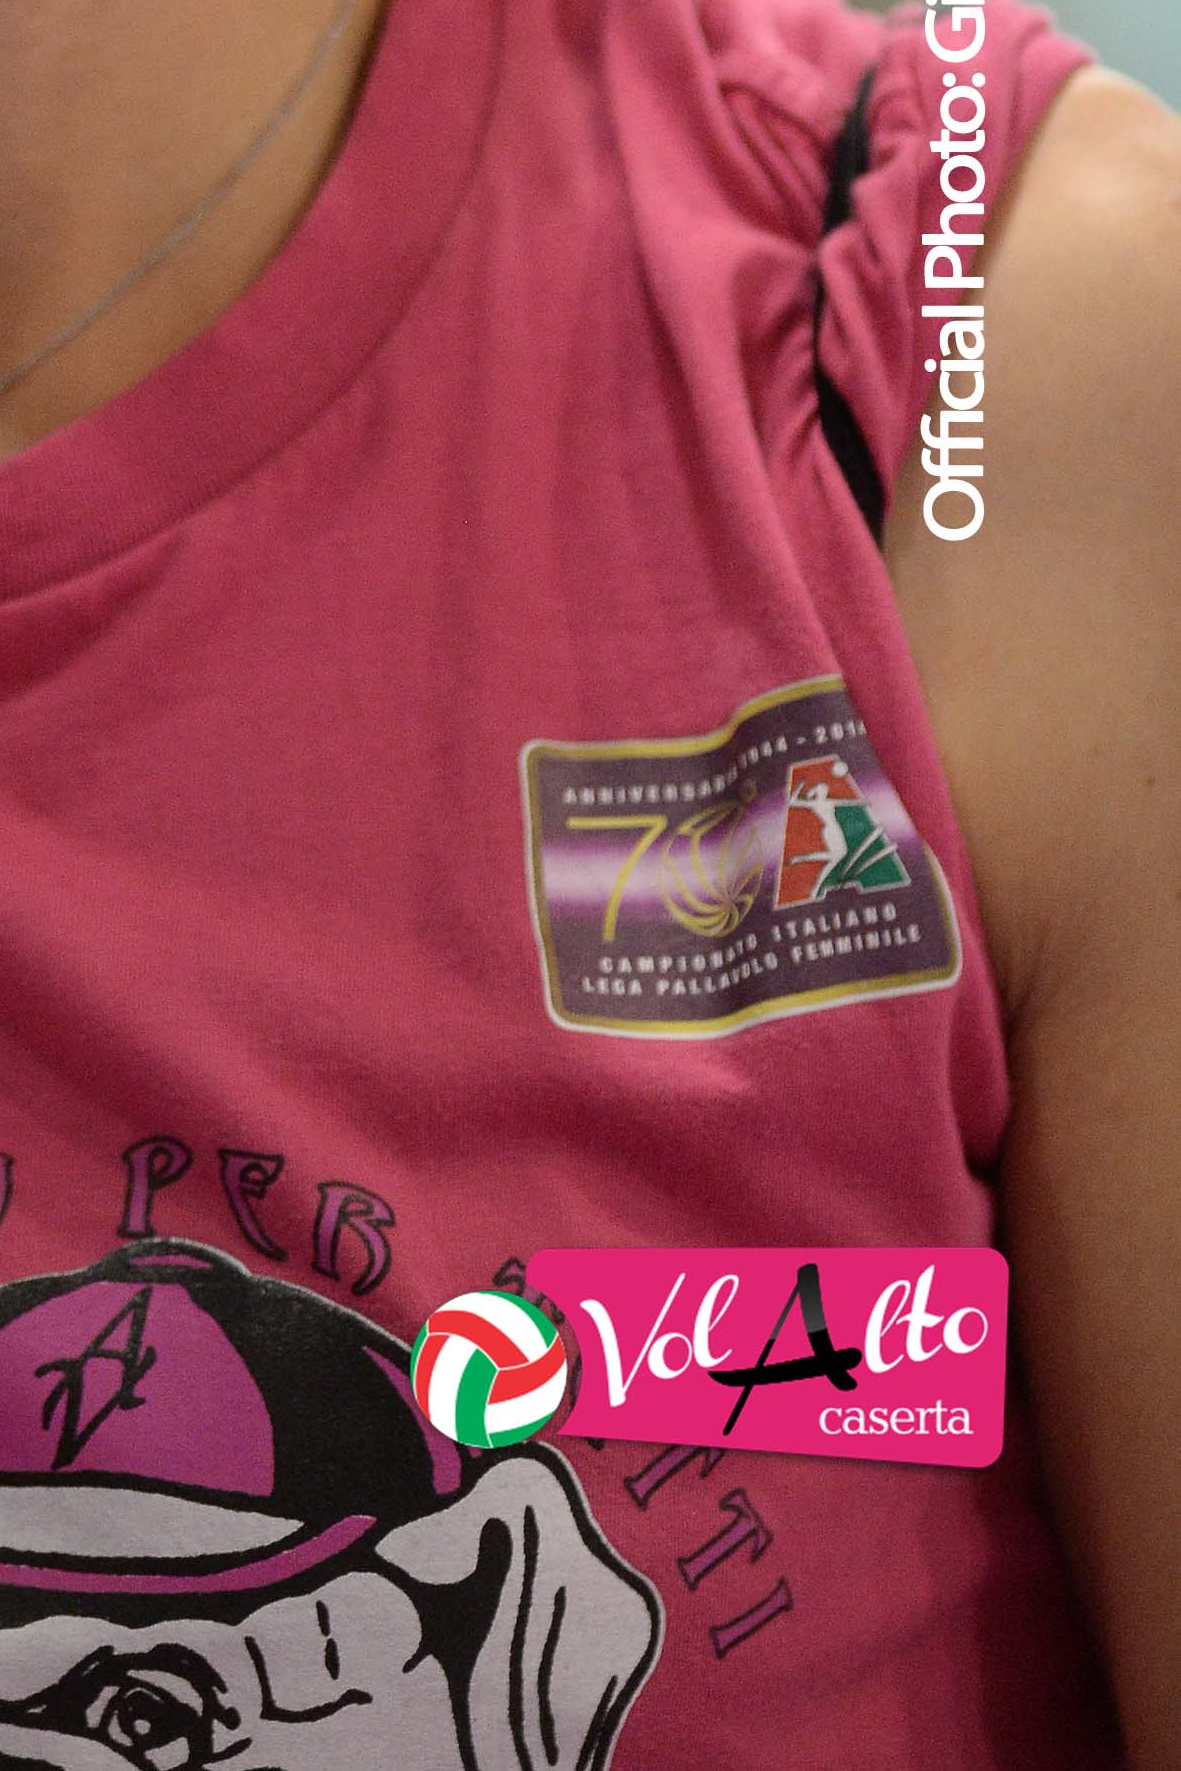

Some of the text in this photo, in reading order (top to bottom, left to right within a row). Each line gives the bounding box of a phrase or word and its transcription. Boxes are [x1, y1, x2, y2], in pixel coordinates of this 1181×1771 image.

[581, 922, 922, 997] LEGA PALLAVOLO FEMMINILE
[598, 902, 897, 974] CAMPIONATO ITALIANO
[116, 1132, 397, 1296] PER
